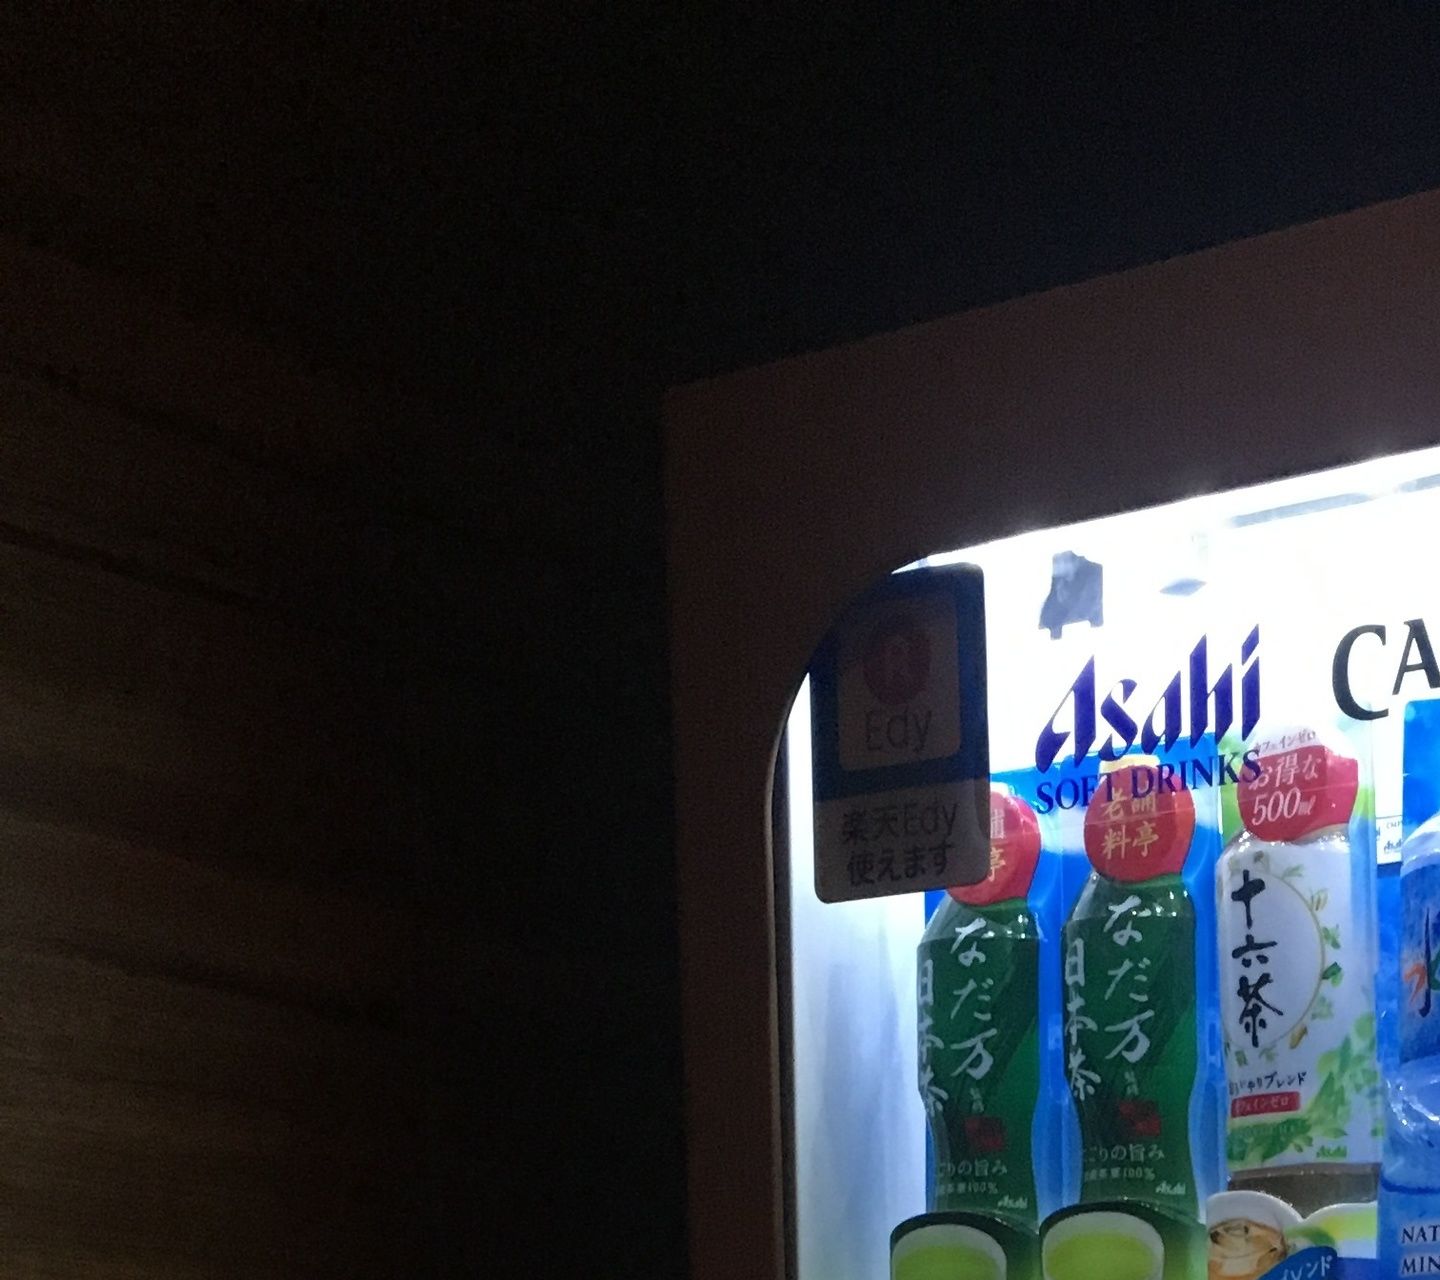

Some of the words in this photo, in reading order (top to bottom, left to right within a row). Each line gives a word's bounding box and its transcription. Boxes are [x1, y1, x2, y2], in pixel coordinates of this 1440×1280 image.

[1035, 624, 1261, 772] Asahi
[842, 802, 958, 844] 楽天Edy
[1036, 774, 1115, 814] SOFT
[1132, 749, 1261, 798] DRINKS
[1249, 753, 1322, 791] お得な
[847, 842, 955, 886] 使えます
[1103, 822, 1160, 860] 料亭
[951, 918, 998, 1080] なだ万
[1106, 895, 1155, 1063] なだ万
[1231, 869, 1283, 1048] 十六茶
[1063, 940, 1101, 1101] 日本茶
